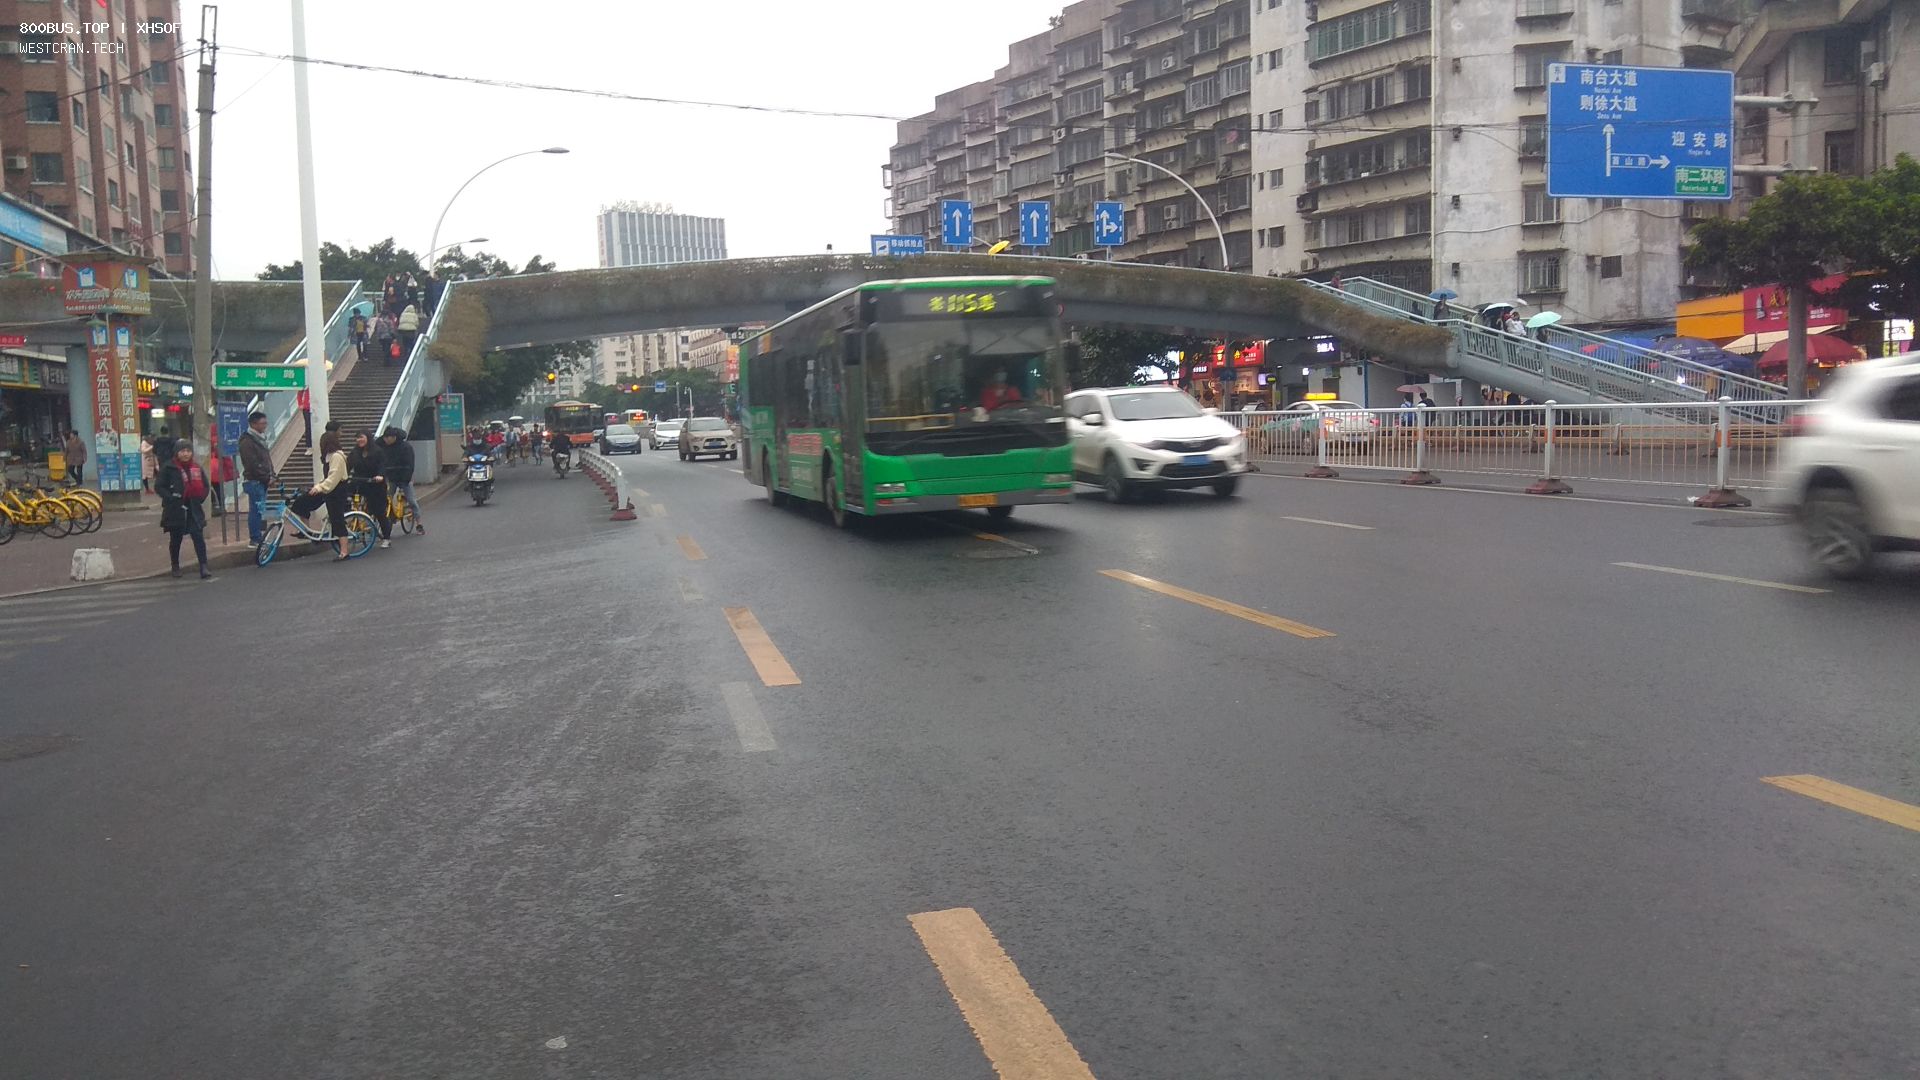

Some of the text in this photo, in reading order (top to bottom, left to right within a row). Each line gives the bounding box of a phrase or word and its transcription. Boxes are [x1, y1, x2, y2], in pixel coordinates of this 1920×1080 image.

[1580, 68, 1638, 87] 南台大道
[1580, 94, 1638, 112] 则徐大道
[1671, 131, 1728, 148] 迎安路
[1676, 167, 1726, 185] 南二环路
